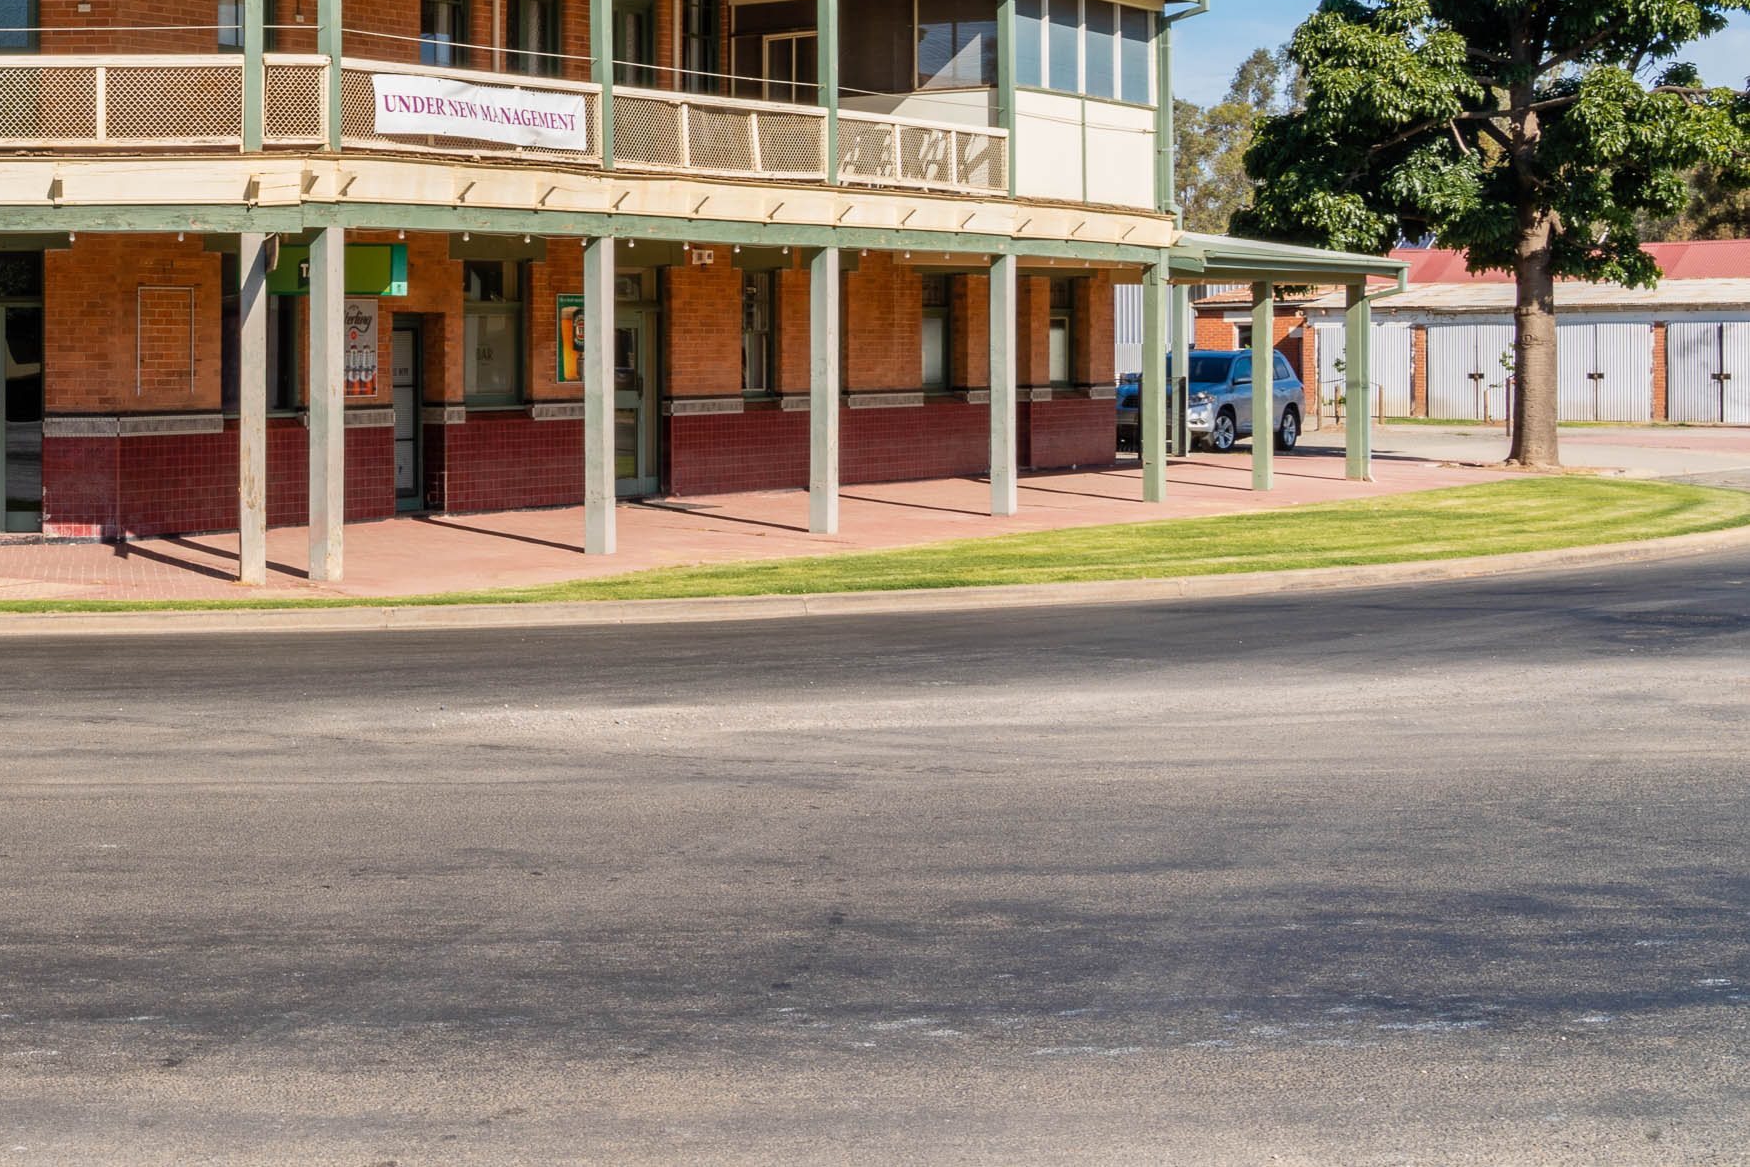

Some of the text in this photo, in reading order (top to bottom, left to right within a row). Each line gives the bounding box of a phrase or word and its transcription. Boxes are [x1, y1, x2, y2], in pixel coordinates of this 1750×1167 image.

[384, 94, 576, 131] UNDER NEW MANAGEMENT
[344, 311, 372, 333] terling
